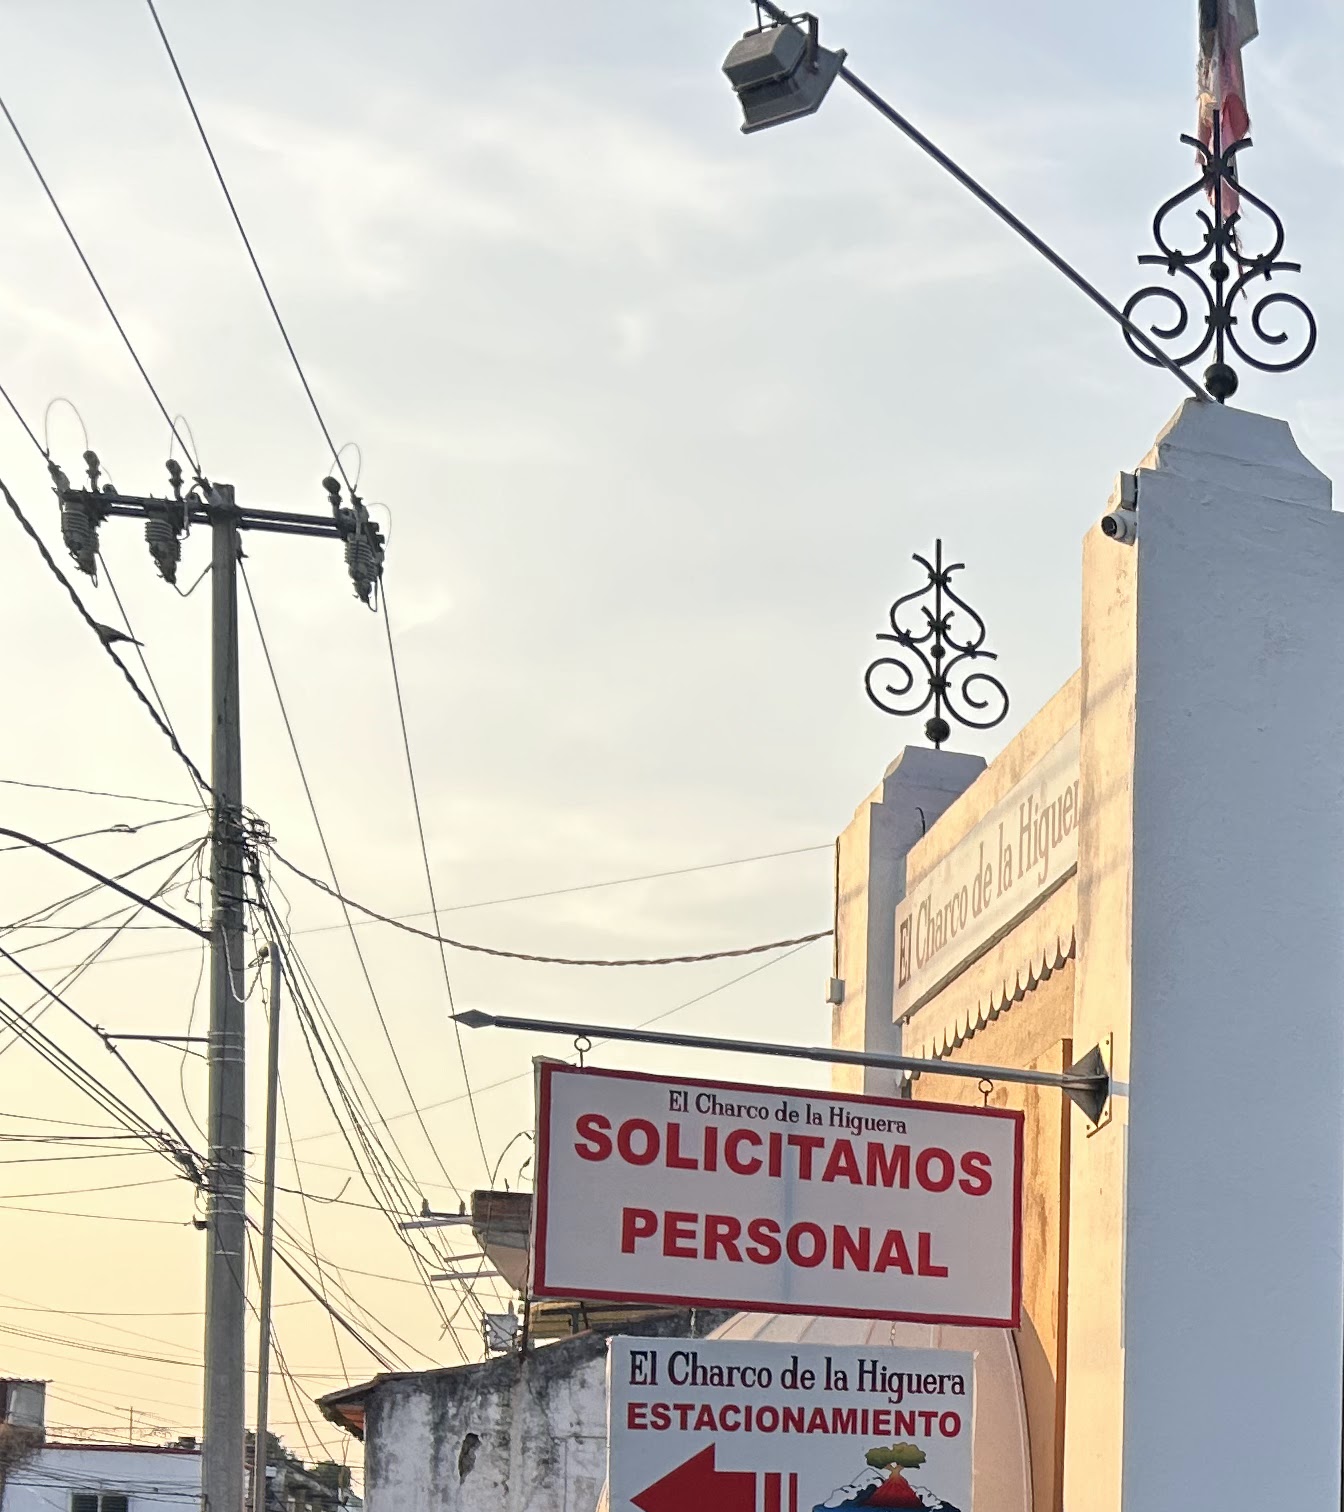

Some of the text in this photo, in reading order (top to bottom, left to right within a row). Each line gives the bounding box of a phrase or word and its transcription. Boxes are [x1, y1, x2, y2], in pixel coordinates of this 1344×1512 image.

[899, 779, 1079, 989] El Charco de la Higuer
[669, 1090, 907, 1136] El Charco de la Higuera
[575, 1113, 993, 1196] SOLICITAMOS
[621, 1207, 949, 1278] PERSONAL
[629, 1350, 966, 1404] El Charco de la Higuera
[626, 1402, 962, 1438] ESTACIONAMIENTO
